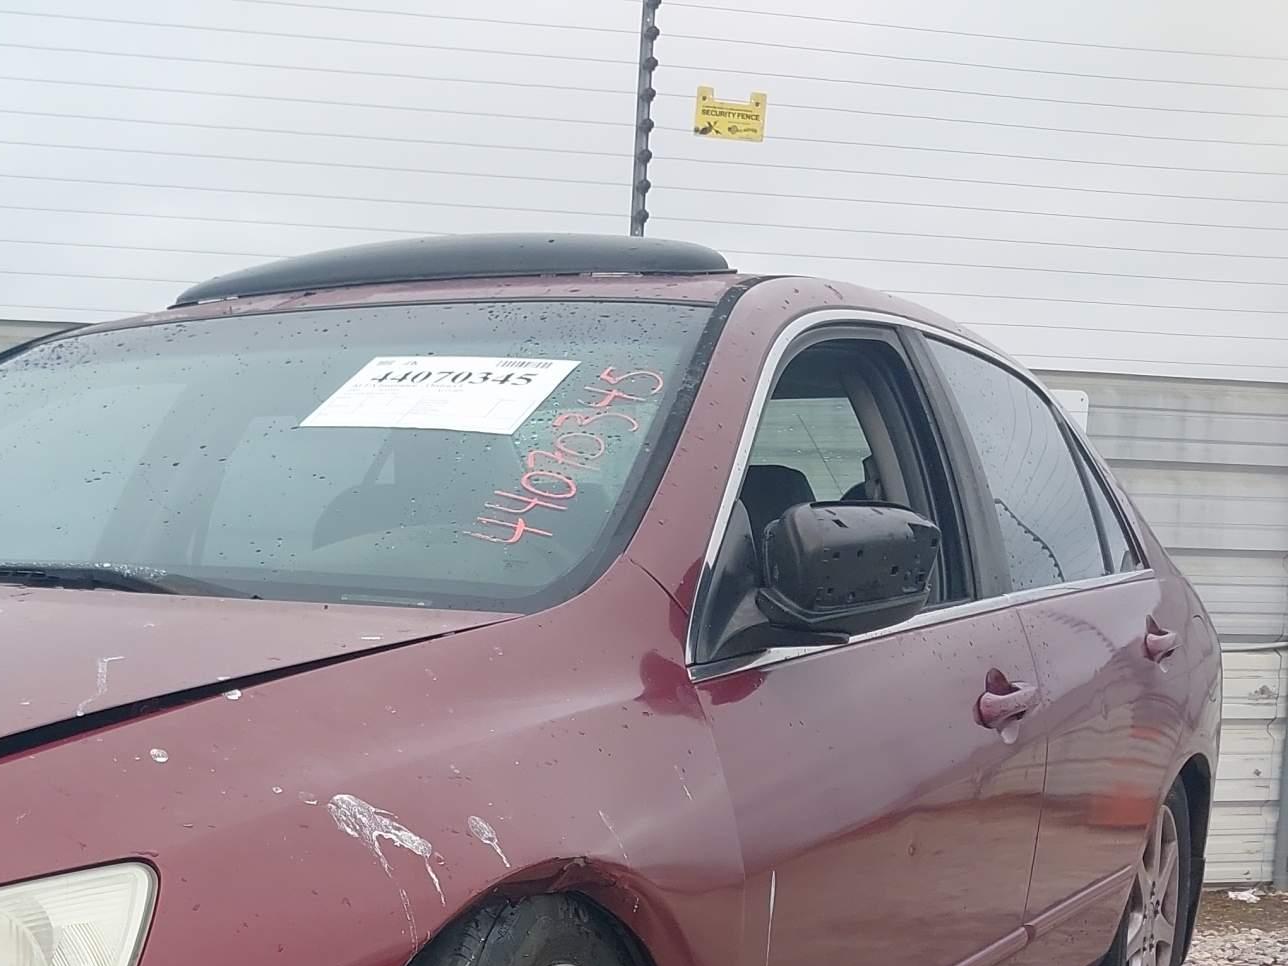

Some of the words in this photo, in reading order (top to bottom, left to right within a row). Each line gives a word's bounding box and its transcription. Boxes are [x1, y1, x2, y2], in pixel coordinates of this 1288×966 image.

[701, 108, 736, 119] SECURITY
[736, 112, 761, 121] FENCE
[370, 369, 539, 387] 44070345
[463, 366, 664, 544] 44070345
